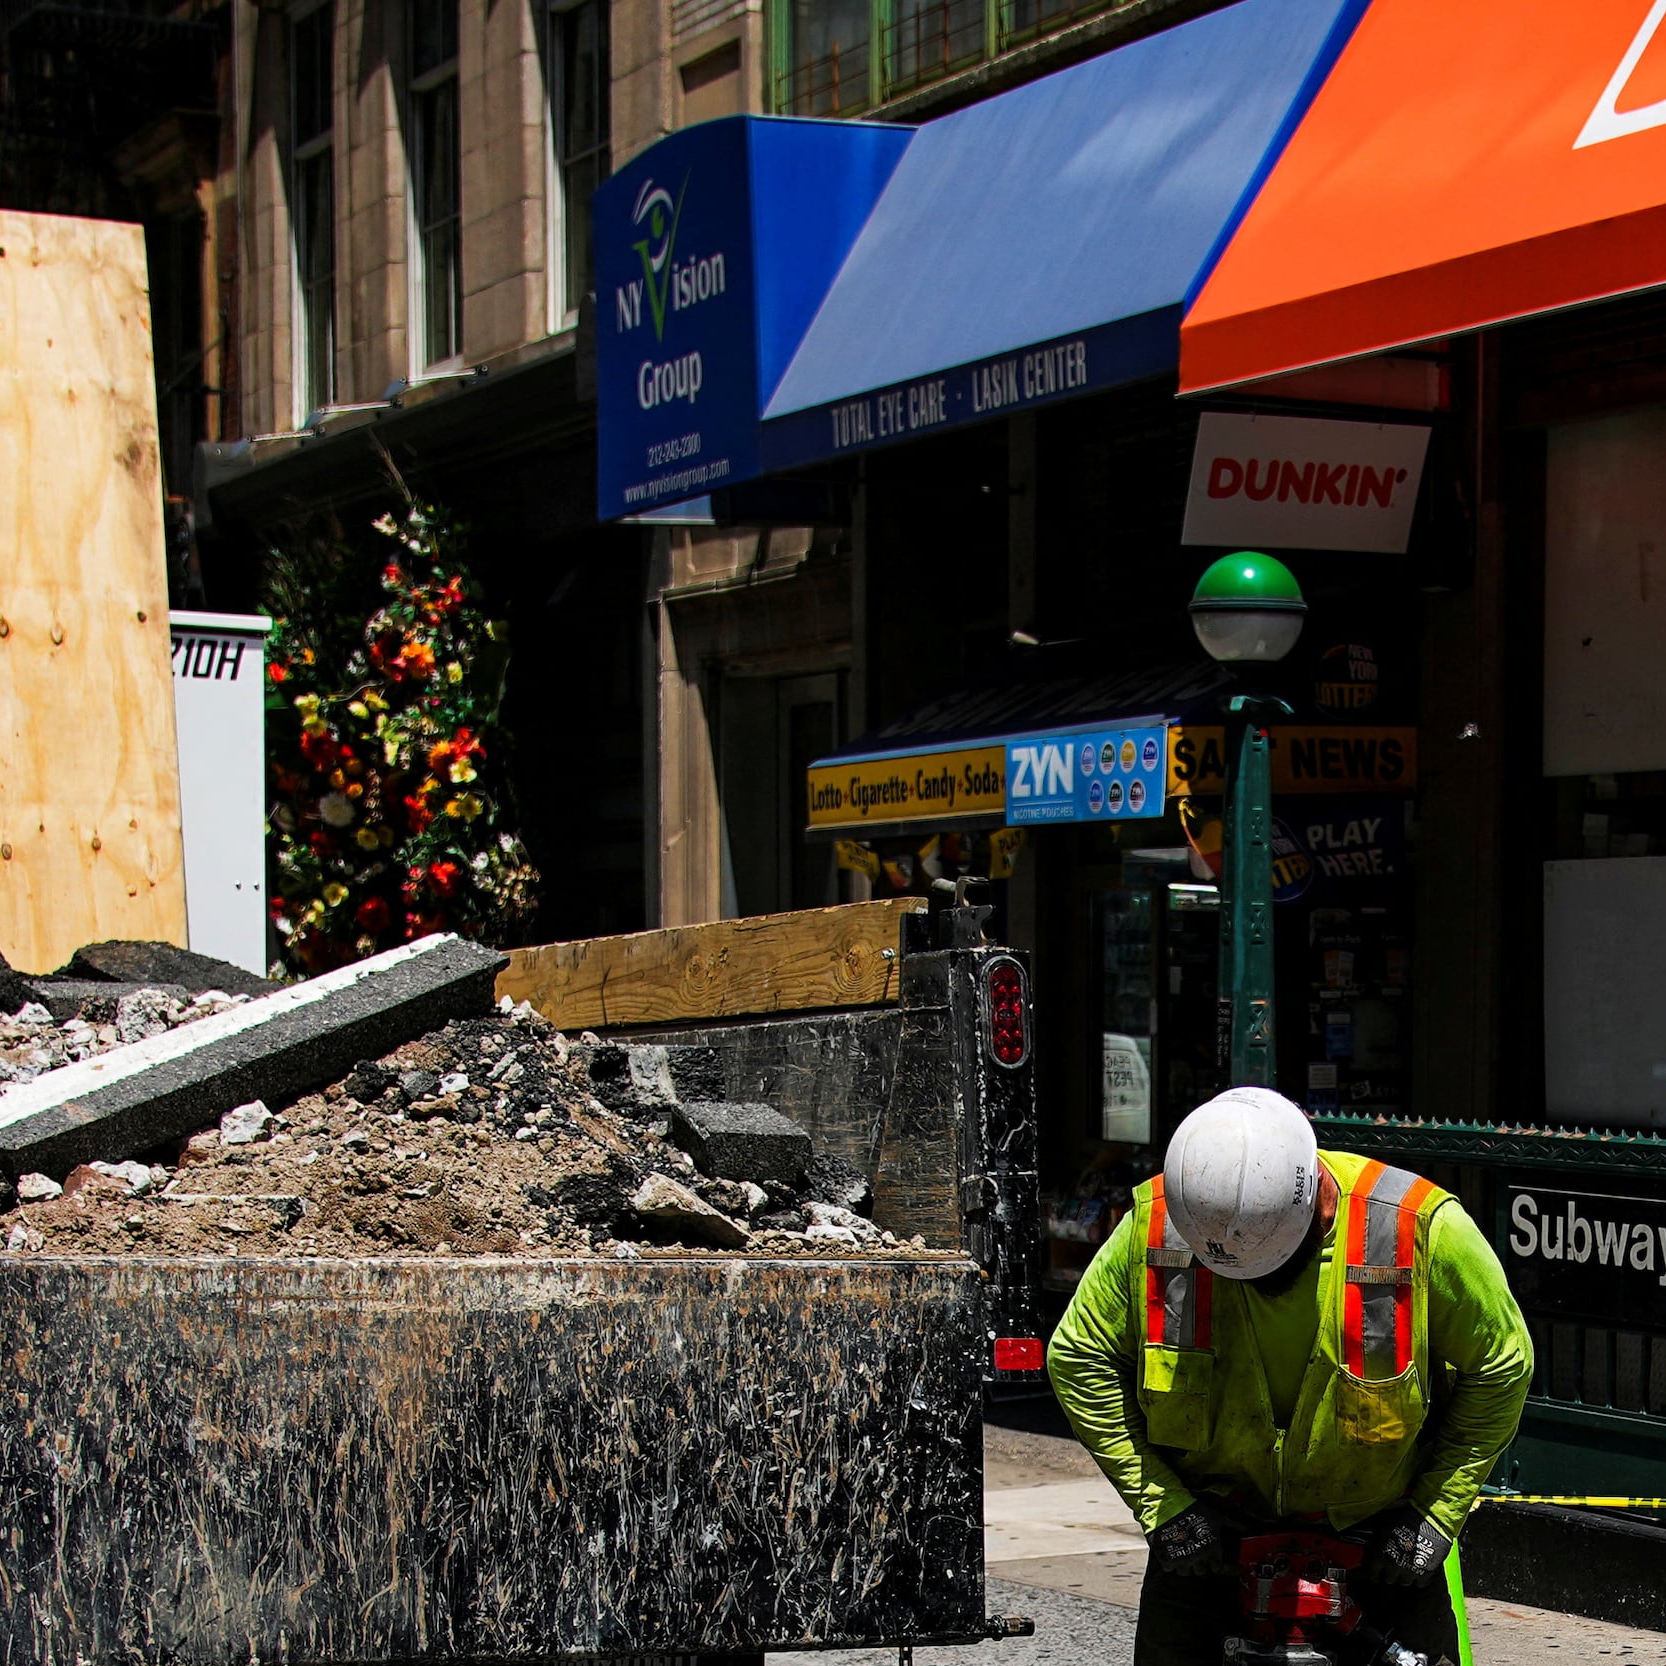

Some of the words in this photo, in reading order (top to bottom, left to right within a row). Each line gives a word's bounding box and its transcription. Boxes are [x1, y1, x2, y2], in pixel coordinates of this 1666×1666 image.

[638, 351, 703, 410] Group
[831, 400, 875, 448] TOTAL
[879, 391, 905, 438] EYE
[907, 379, 947, 430] CARE
[971, 359, 1019, 413] LASIK
[1023, 340, 1087, 400] CENTER
[1206, 457, 1408, 509] DUNKIN'
[915, 768, 956, 807] Candy
[964, 762, 999, 791] Soda
[1011, 742, 1075, 798] ZYN
[1290, 739, 1404, 781] NEWS
[1306, 816, 1384, 851] PLAY
